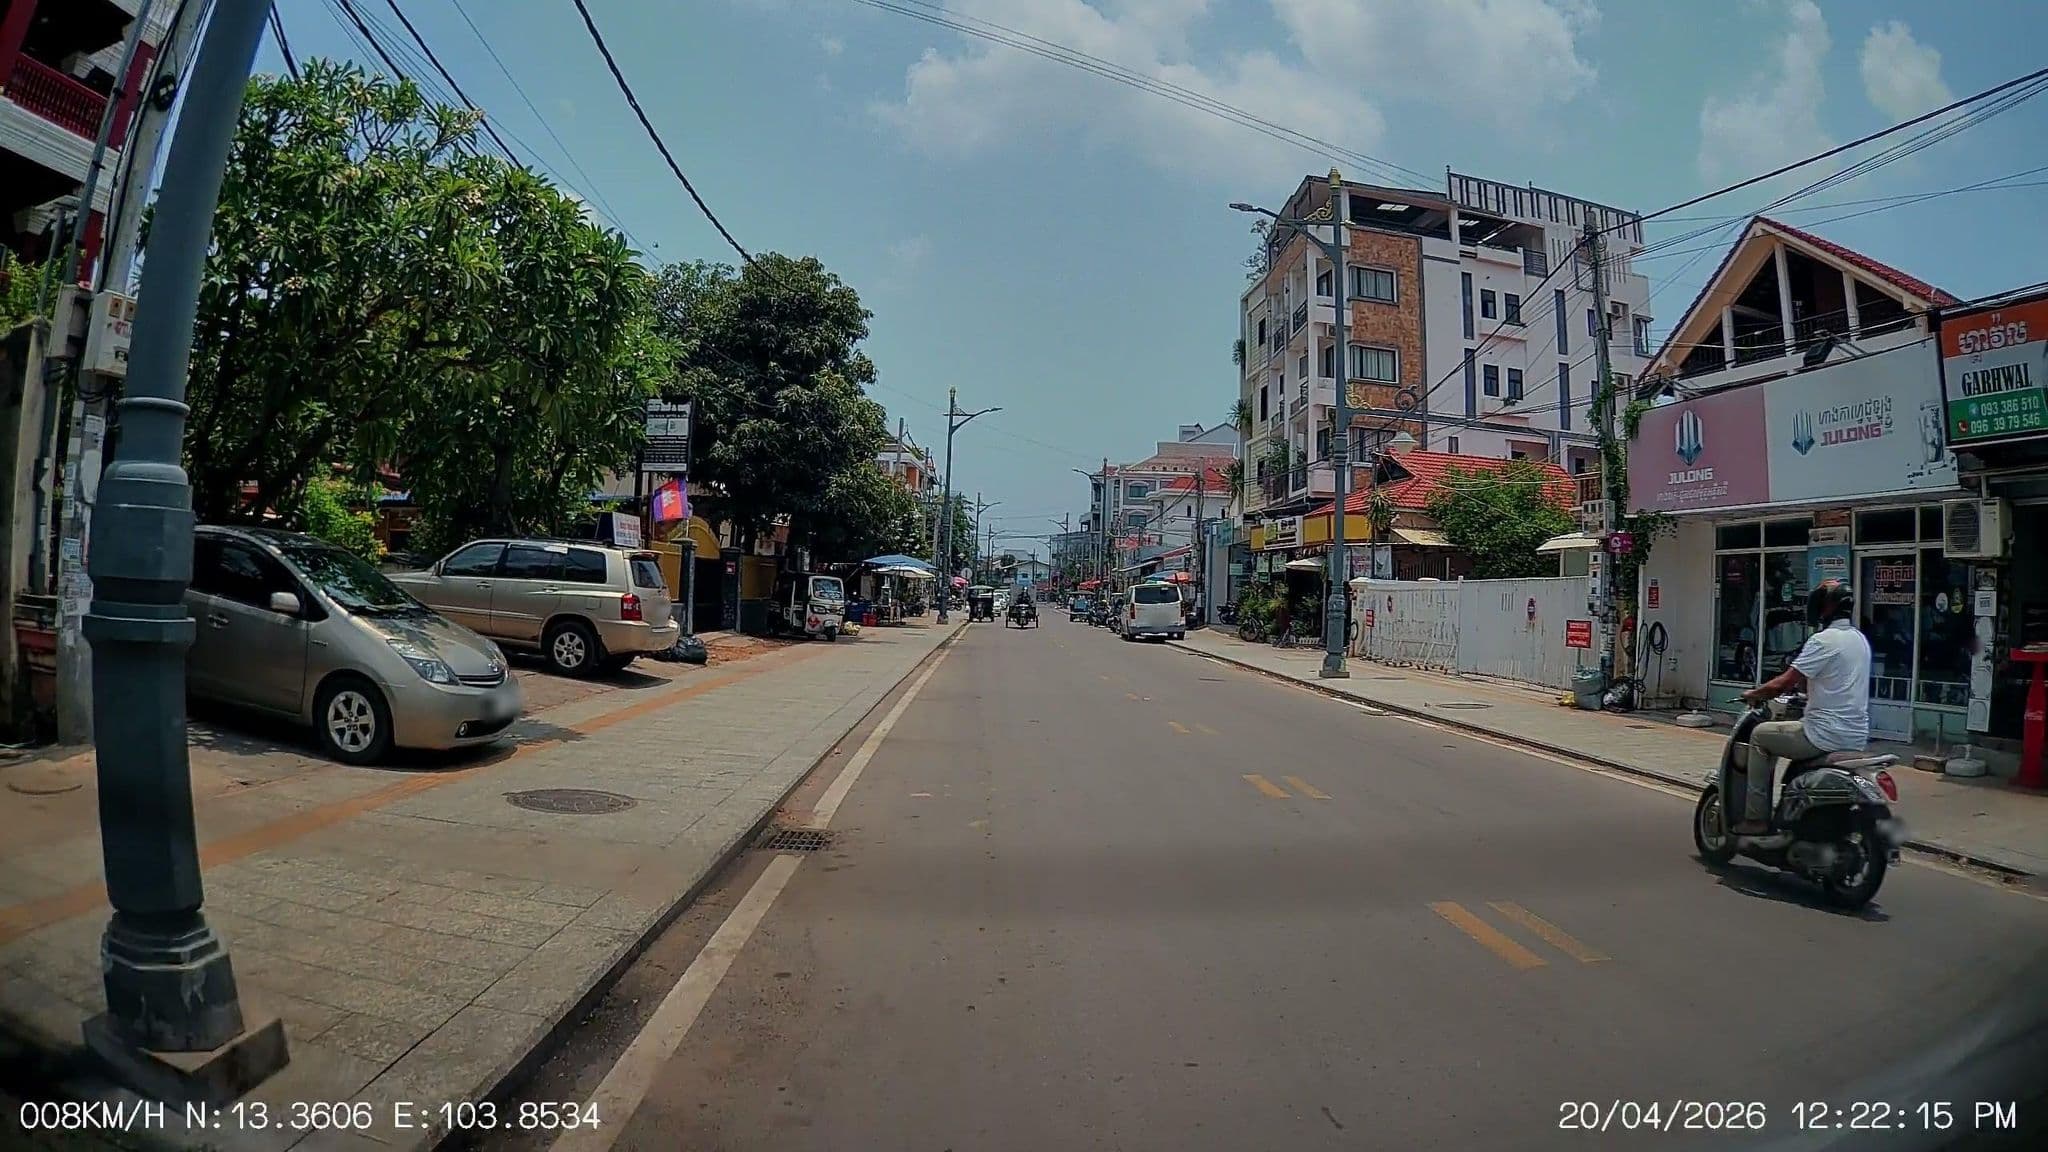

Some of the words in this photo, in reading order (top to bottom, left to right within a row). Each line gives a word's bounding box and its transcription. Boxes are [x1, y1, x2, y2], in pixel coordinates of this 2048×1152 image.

[1961, 362, 2033, 396] GARHWAL
[1980, 401, 1999, 417] 093
[2000, 399, 2019, 414] 386
[2021, 396, 2040, 411] 510
[1970, 419, 1989, 434] 096
[1993, 417, 2005, 431] 39
[2007, 415, 2020, 430] 79
[2022, 413, 2040, 427] 546
[1820, 422, 1882, 447] JULONG
[1667, 467, 1714, 485] JULONG
